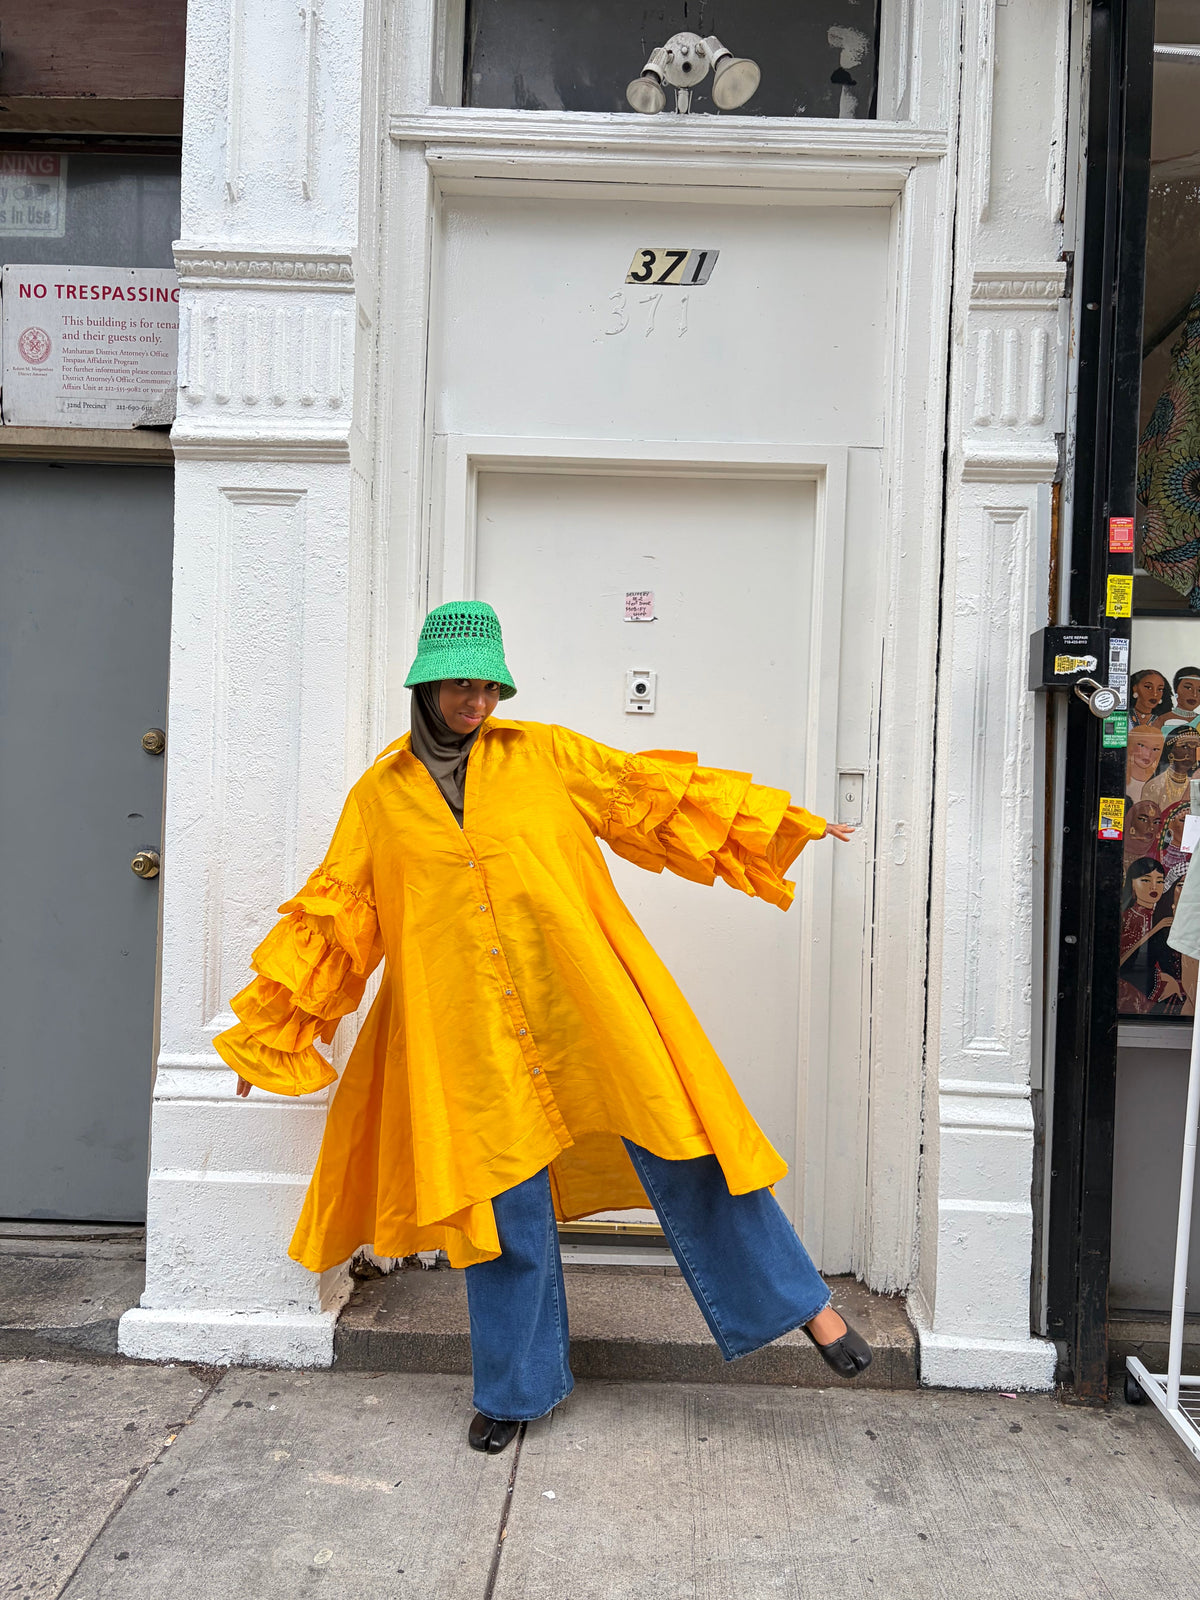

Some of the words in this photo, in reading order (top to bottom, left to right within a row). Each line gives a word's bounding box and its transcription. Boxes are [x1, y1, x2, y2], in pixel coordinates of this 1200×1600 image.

[12, 206, 23, 224] In
[28, 206, 50, 224] Use
[630, 249, 708, 283] 371
[19, 283, 48, 299] NO
[54, 284, 180, 303] TRESPASSING
[62, 315, 84, 326] This
[86, 316, 127, 331] building
[129, 318, 137, 328] is
[139, 317, 154, 328] for
[62, 330, 80, 341] and
[83, 330, 105, 341] their
[108, 333, 137, 344] guests
[139, 333, 162, 346] only.
[62, 347, 94, 355] Manhattan
[96, 348, 118, 356] District
[119, 348, 149, 358] Attorney's
[150, 350, 169, 358] Office
[63, 356, 86, 365] Trespass
[87, 357, 112, 365] Affidavit
[113, 358, 139, 367] Program
[132, 368, 150, 376] please
[62, 374, 84, 382] District
[85, 375, 115, 384] Attorney's
[136, 377, 171, 386] Community
[62, 383, 82, 391] Affairs
[67, 401, 82, 410] 32nd
[83, 402, 107, 410] Precinct
